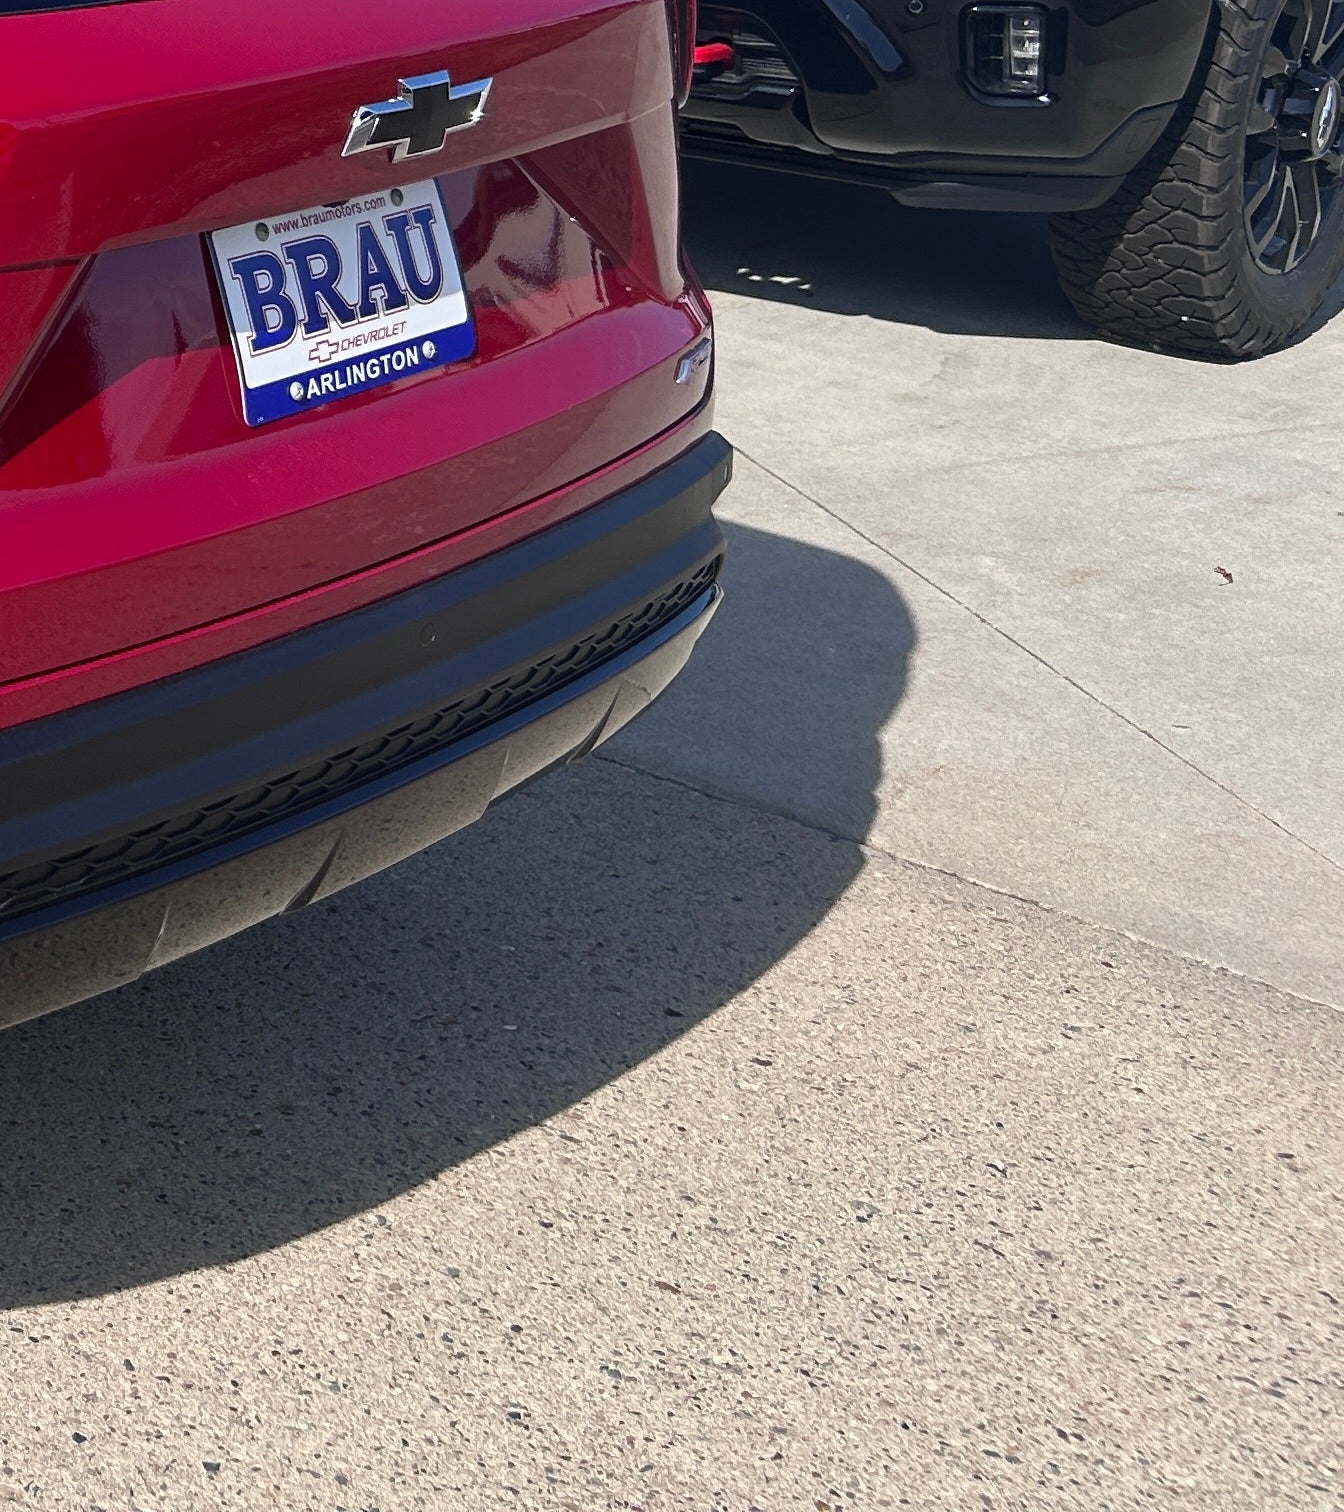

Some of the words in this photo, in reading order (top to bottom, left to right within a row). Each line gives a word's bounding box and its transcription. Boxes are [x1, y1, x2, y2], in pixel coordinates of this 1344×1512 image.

[271, 195, 386, 235] www.braumotors.com
[227, 203, 444, 358] BRAU
[340, 320, 408, 352] CHEVROLET
[307, 345, 420, 399] ARLINGTON
